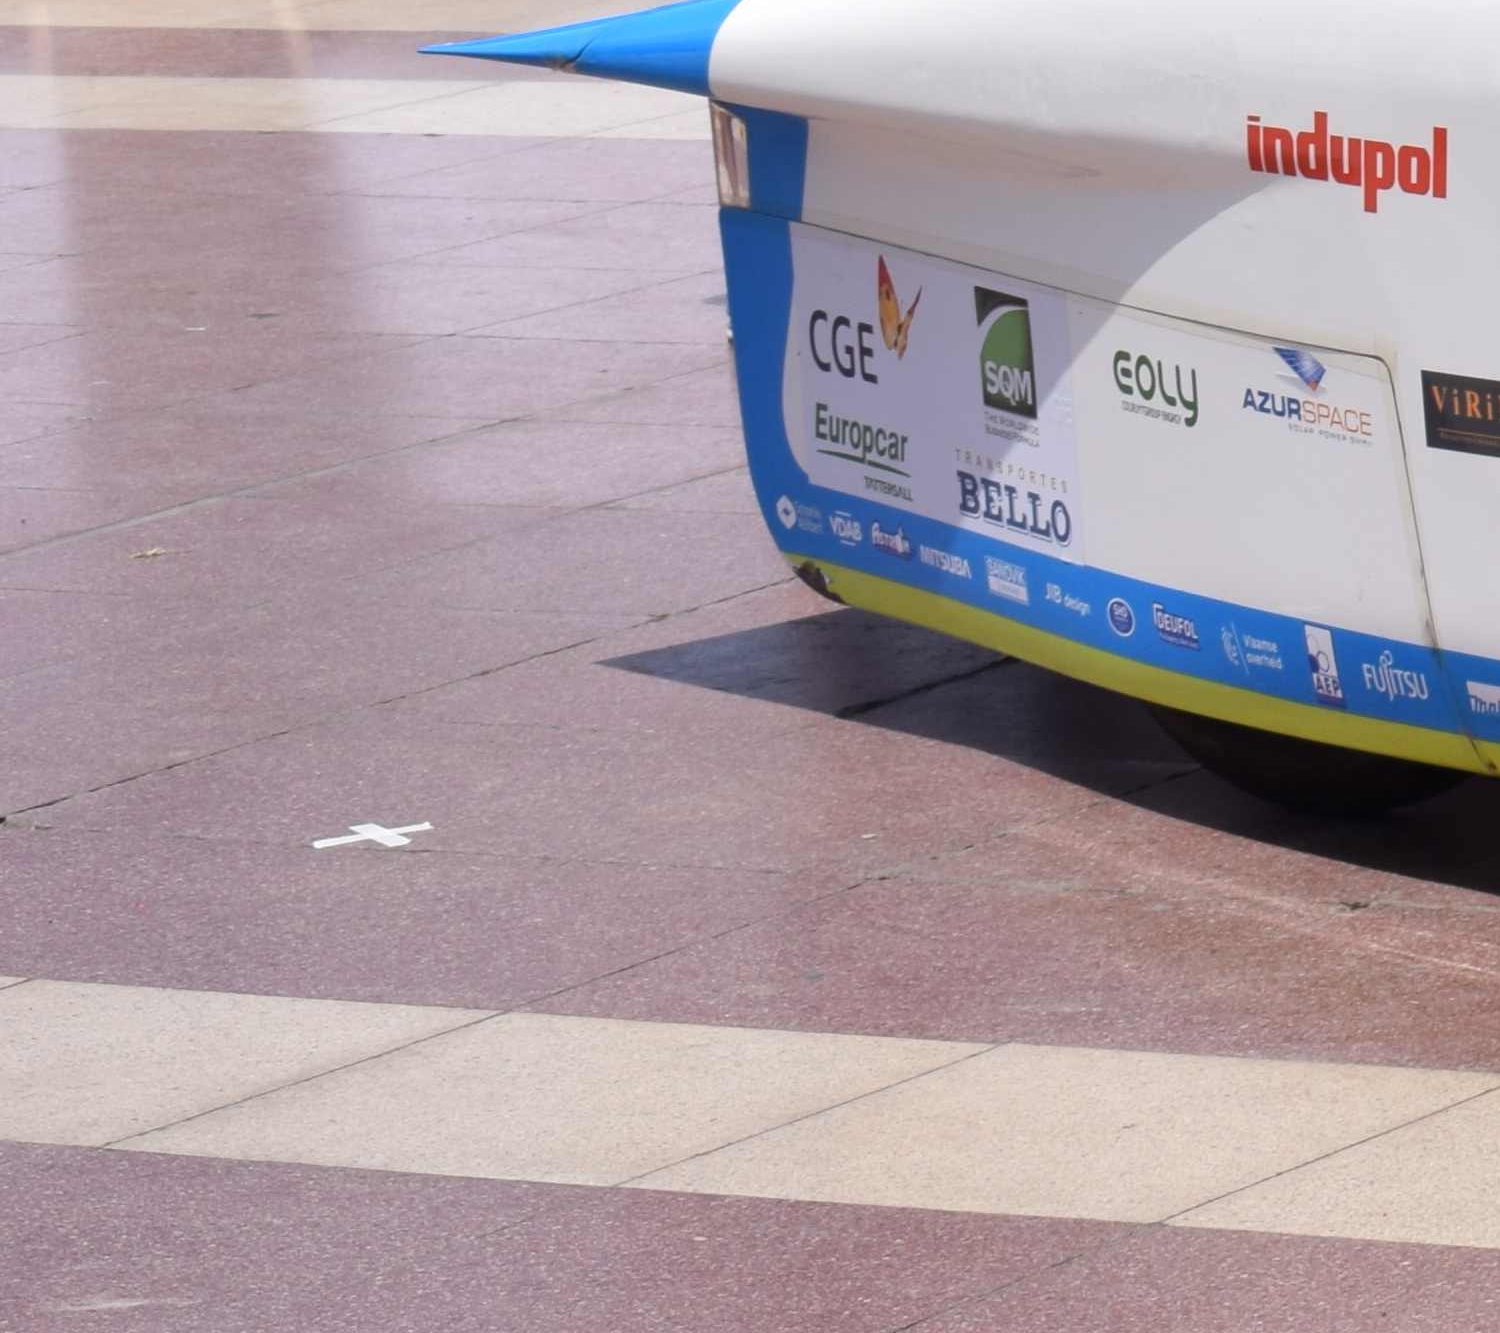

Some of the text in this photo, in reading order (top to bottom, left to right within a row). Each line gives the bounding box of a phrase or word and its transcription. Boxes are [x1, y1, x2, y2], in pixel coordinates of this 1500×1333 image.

[1246, 110, 1448, 214] indupol
[808, 309, 879, 385] CGE
[984, 360, 1034, 407] SQM
[814, 401, 909, 464] Europcar
[864, 475, 914, 503] TATTERSALL
[954, 448, 1068, 494] TRANSPORTES
[829, 514, 863, 543] VDAB
[956, 469, 1073, 548] BELLO
[919, 544, 973, 580] MITSUBA
[1156, 611, 1199, 640] DEUFOL
[1243, 634, 1279, 654] Vlaamse
[1312, 674, 1341, 698] AEP
[1361, 662, 1429, 702] FUJITSU
